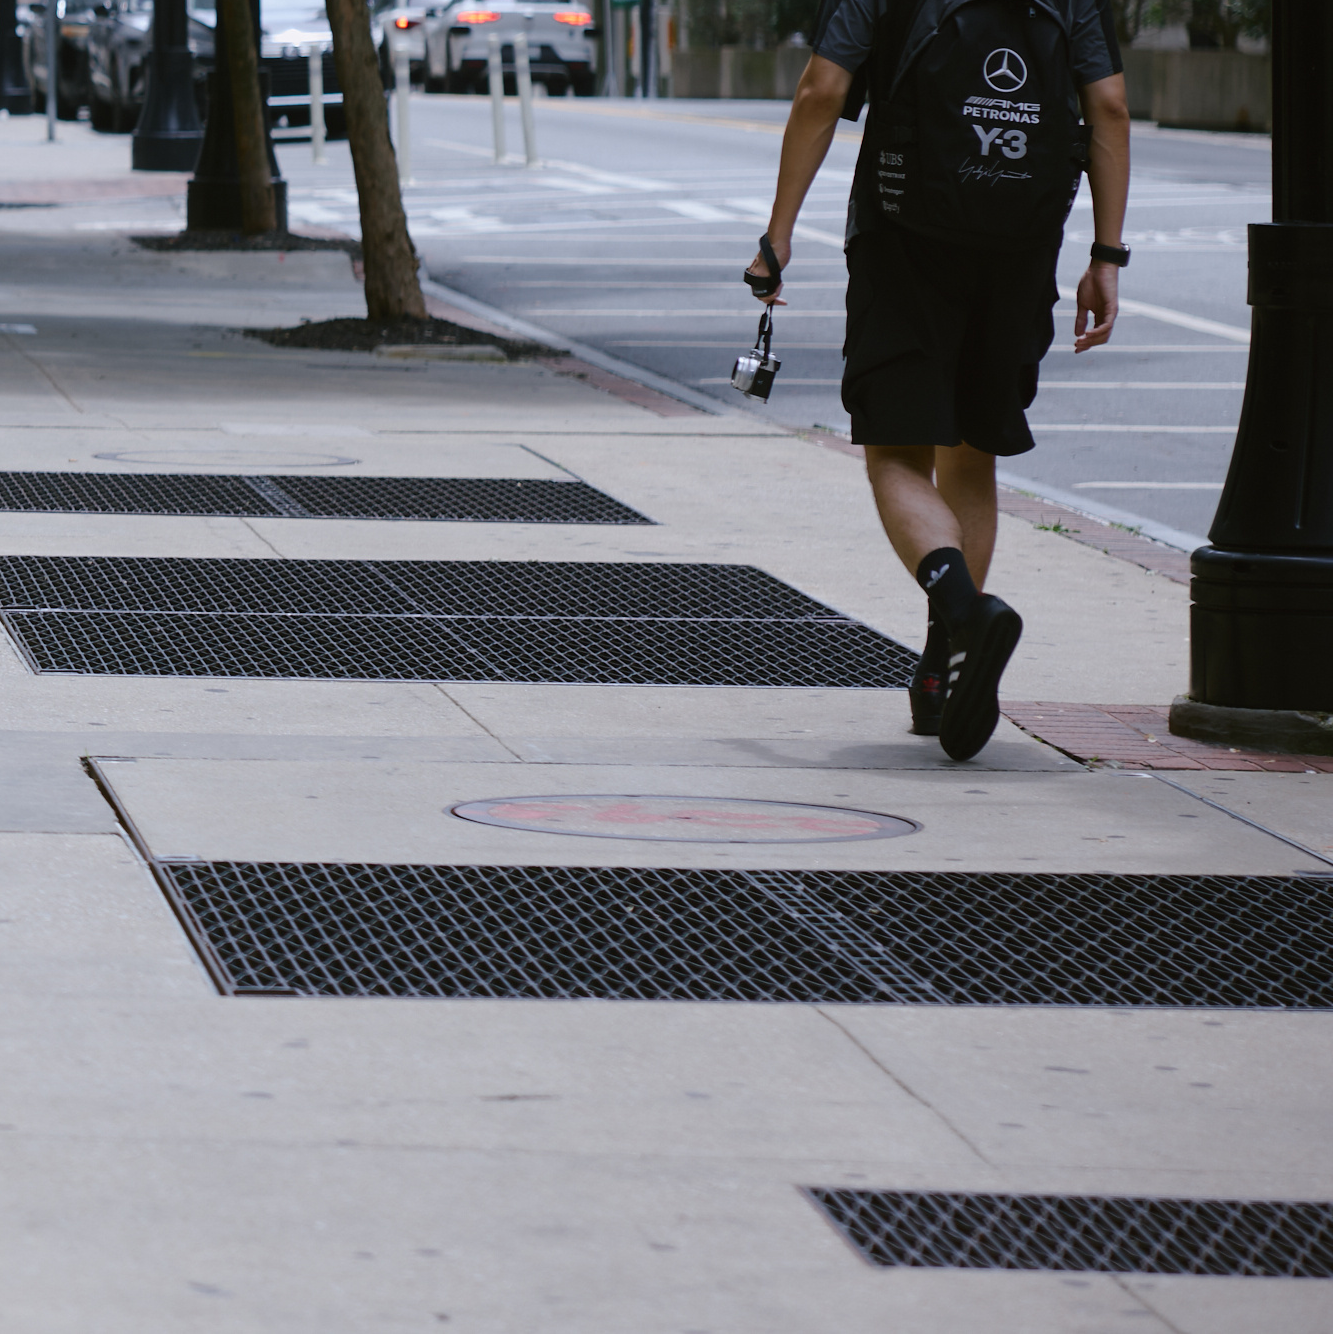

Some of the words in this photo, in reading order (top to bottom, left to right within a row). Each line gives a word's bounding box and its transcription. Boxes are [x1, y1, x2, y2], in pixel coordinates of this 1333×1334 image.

[986, 97, 1041, 112] AMG
[962, 105, 1040, 124] PETRONAS
[971, 124, 1028, 159] Y-3
[885, 152, 904, 166] UBS
